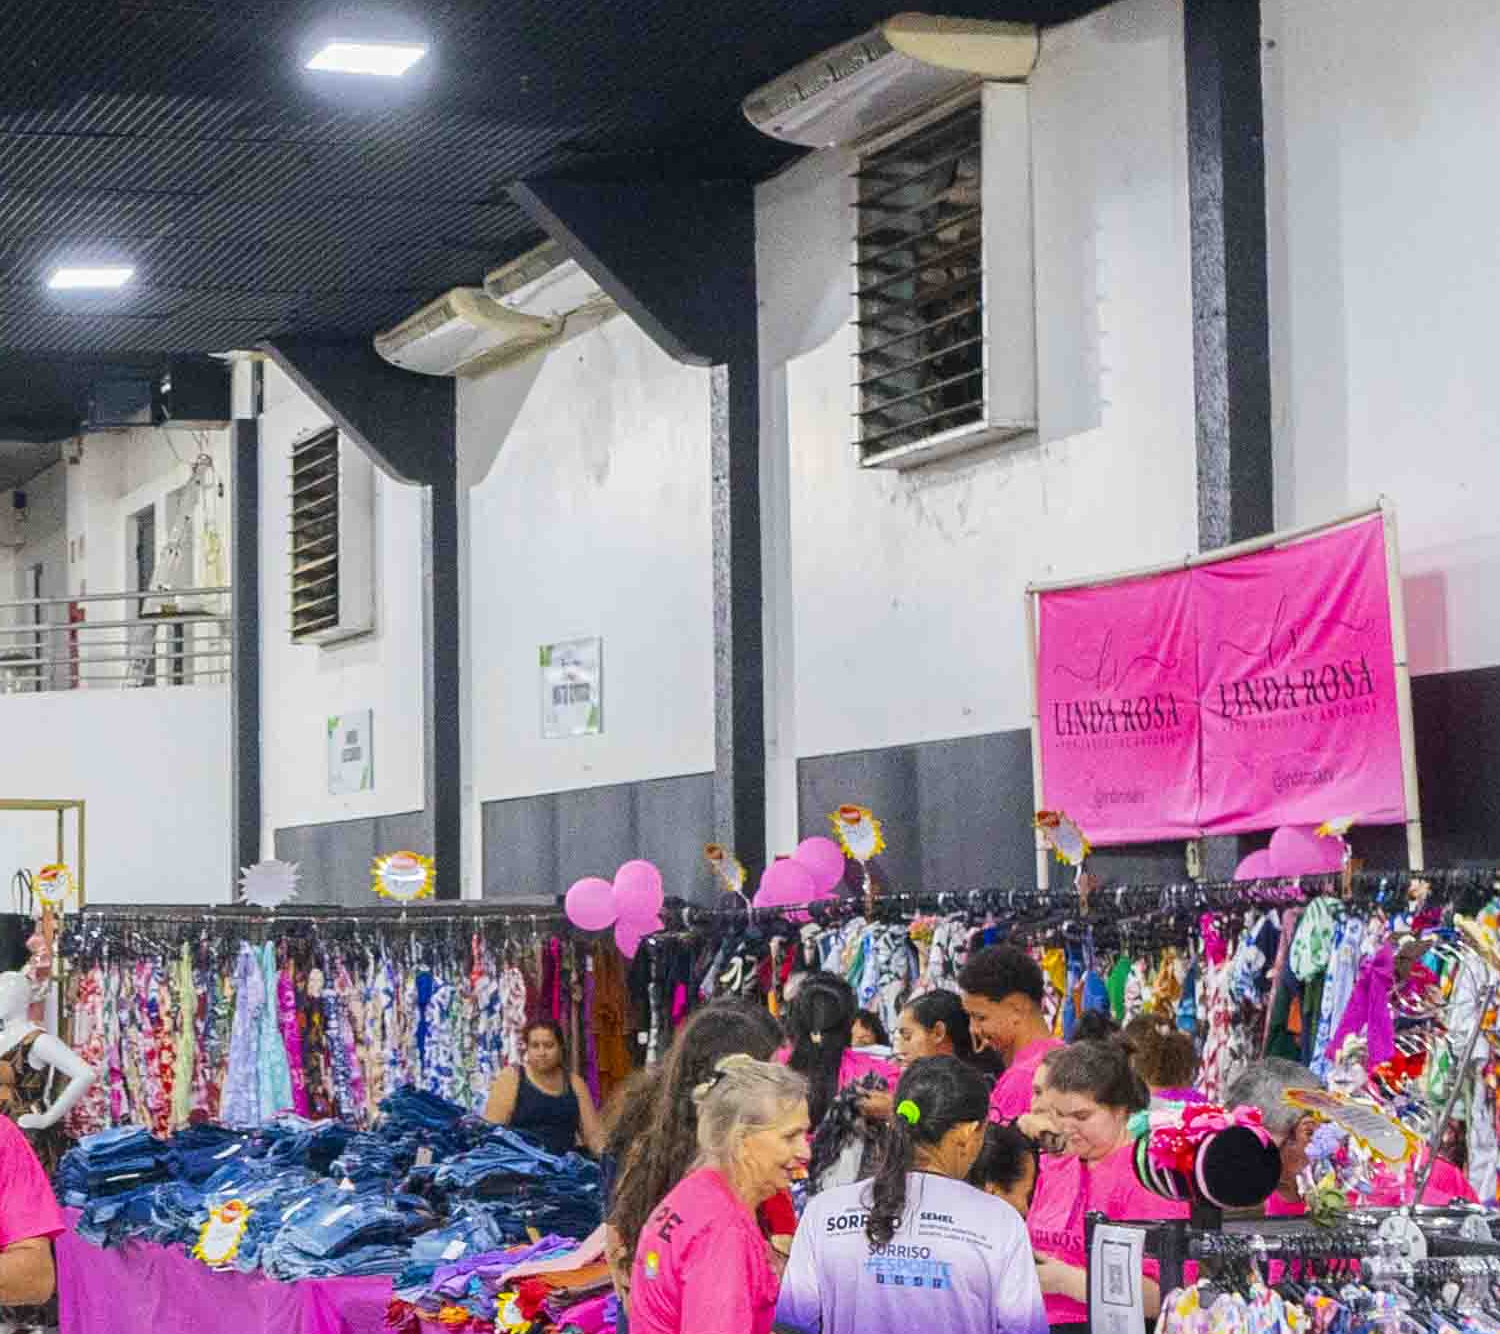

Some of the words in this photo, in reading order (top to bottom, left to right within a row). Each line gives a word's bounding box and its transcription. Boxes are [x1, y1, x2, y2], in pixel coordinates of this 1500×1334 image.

[1219, 674, 1298, 719] LINDA
[1304, 651, 1375, 706] ROSA
[1053, 698, 1119, 737] LINDA
[1122, 692, 1182, 734] ROSA
[867, 1243, 931, 1260] SORRISO
